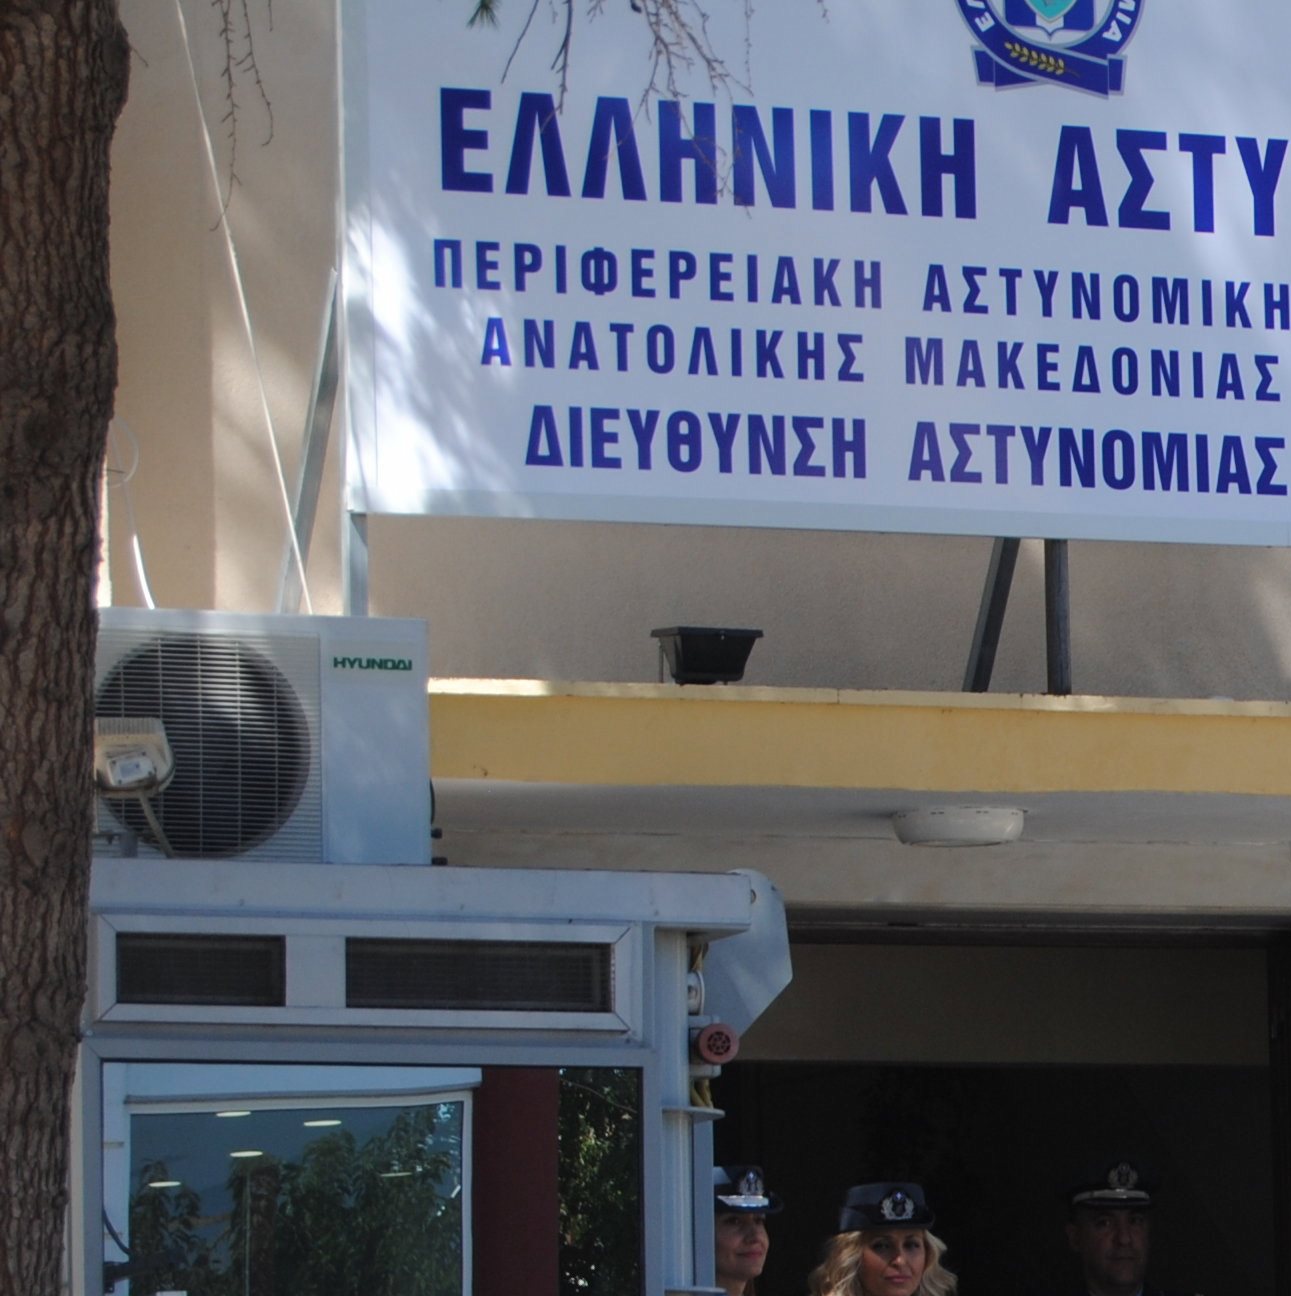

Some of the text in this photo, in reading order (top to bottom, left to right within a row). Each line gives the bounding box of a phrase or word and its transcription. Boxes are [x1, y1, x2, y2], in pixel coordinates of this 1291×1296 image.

[440, 87, 977, 220] ΕΛΛΗΝΙΚΗ
[433, 238, 882, 309] ΠΕΡΙΦΕΡΕΙΑΚΗ
[922, 264, 1291, 330] ΑΣΤΥΝΟΜΙΚΗ
[480, 316, 865, 382] ΑΝΑΤΟΛΙΚΗΣ
[904, 336, 1281, 402] ΜΑΚΕΔΟΝΙΑΣ
[524, 404, 867, 479] ΔΙΕΥΘΥΝΣΗ
[907, 420, 1288, 496] ΑΣΤΥΝΟΜΙΑΣ
[333, 656, 413, 671] HYUNDAI
